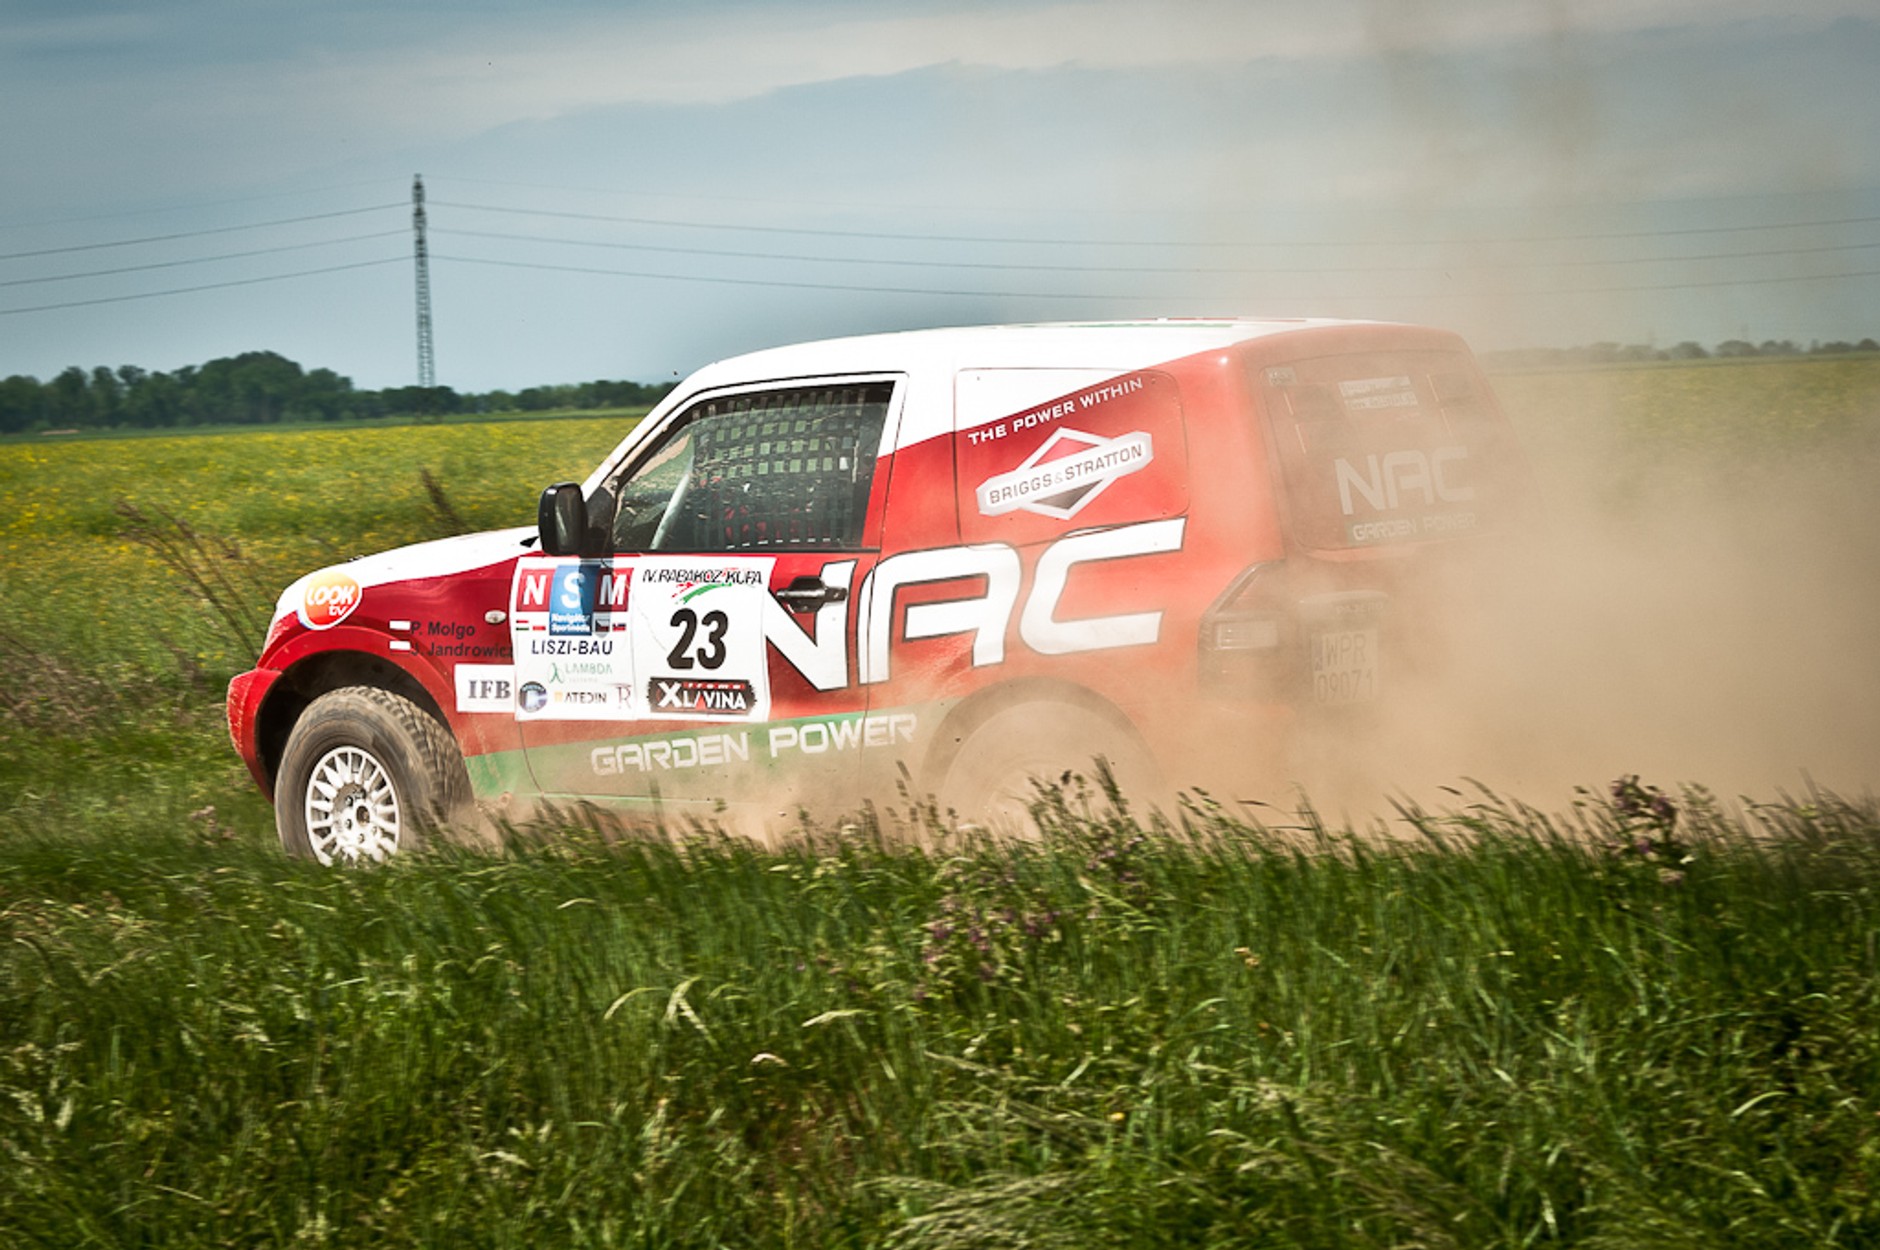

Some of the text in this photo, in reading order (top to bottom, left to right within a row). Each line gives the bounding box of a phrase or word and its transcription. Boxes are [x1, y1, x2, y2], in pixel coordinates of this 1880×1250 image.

[968, 377, 1143, 445] THE POWER WITHIN
[1334, 447, 1475, 515] NAC
[1352, 512, 1481, 541] GARDEN POWER
[306, 585, 355, 605] LOOK
[766, 517, 1186, 691] NAC
[329, 606, 348, 616] tv
[428, 621, 475, 639] Molgo
[667, 608, 728, 669] 23
[531, 640, 613, 655] LISZI-BAU
[1326, 633, 1367, 667] WPR
[565, 663, 613, 675] LAMBDA
[468, 680, 511, 699] IFB
[1316, 668, 1374, 702] 09071
[591, 713, 917, 776] GARDEN POWER
